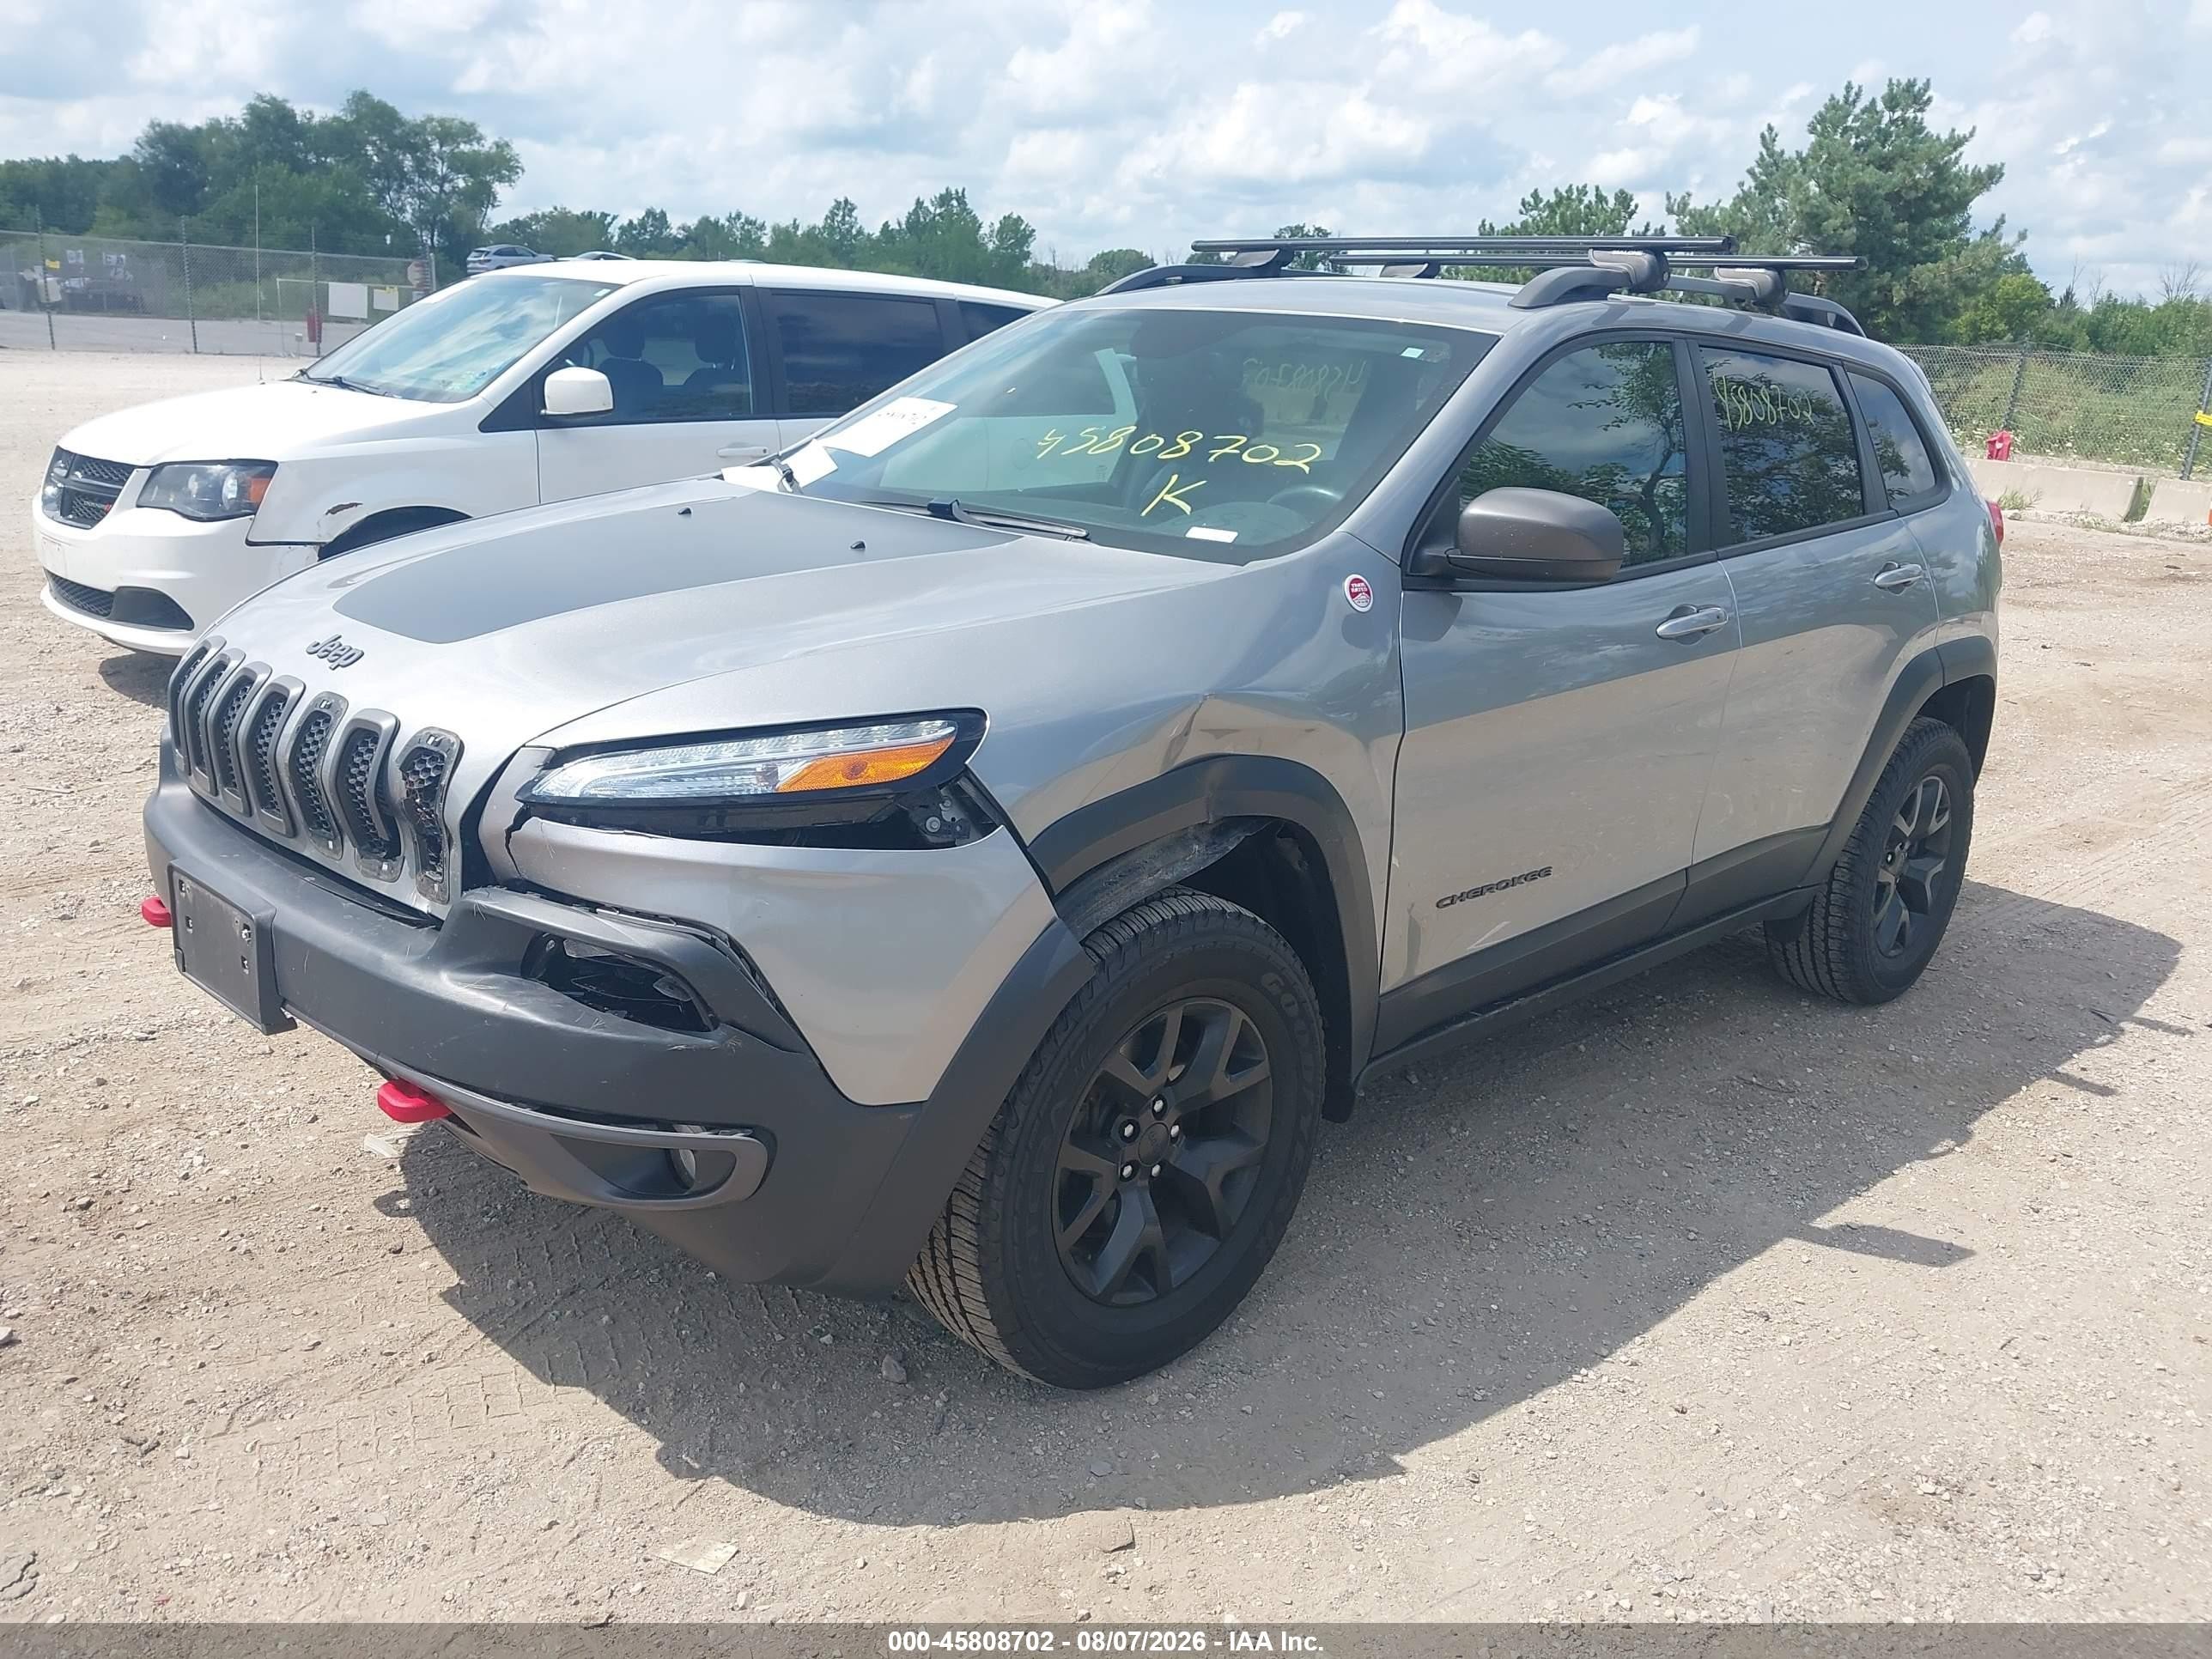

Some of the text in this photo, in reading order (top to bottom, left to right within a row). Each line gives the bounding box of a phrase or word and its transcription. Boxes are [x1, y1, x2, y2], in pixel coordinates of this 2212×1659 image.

[1036, 425, 1322, 475] 45808702
[1140, 473, 1208, 517] K
[306, 635, 365, 671] Jeep
[1436, 866, 1553, 909] CHEROKEE
